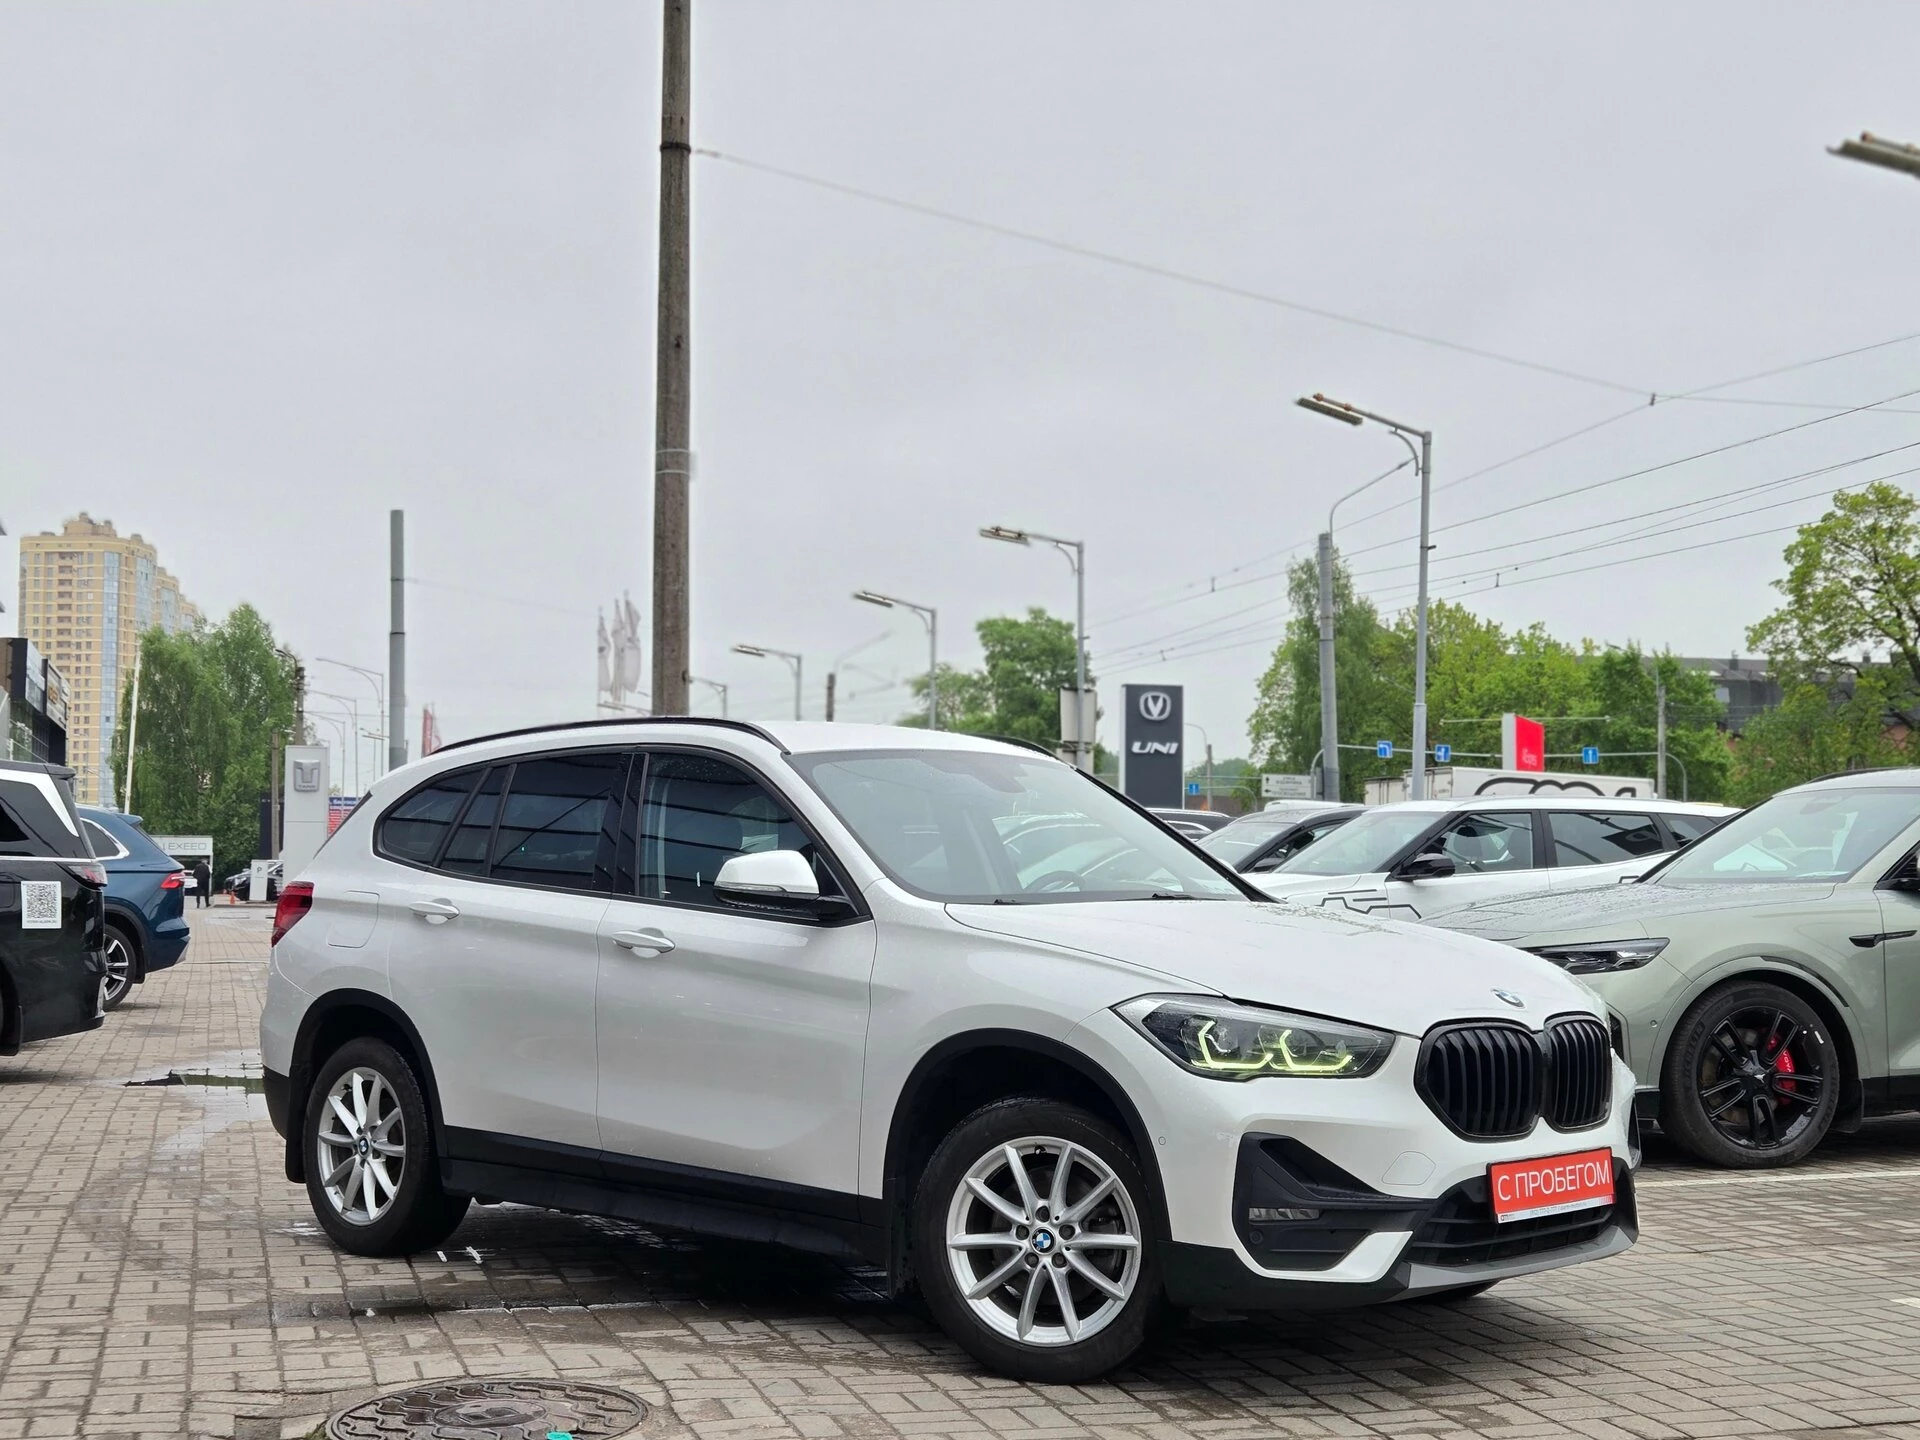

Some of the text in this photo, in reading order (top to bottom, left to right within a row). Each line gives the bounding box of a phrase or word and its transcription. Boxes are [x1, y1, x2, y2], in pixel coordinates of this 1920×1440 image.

[1131, 741, 1178, 754] UNI
[168, 842, 207, 851] EXEED
[1497, 1159, 1611, 1201] С ПРОБЕГОМ
